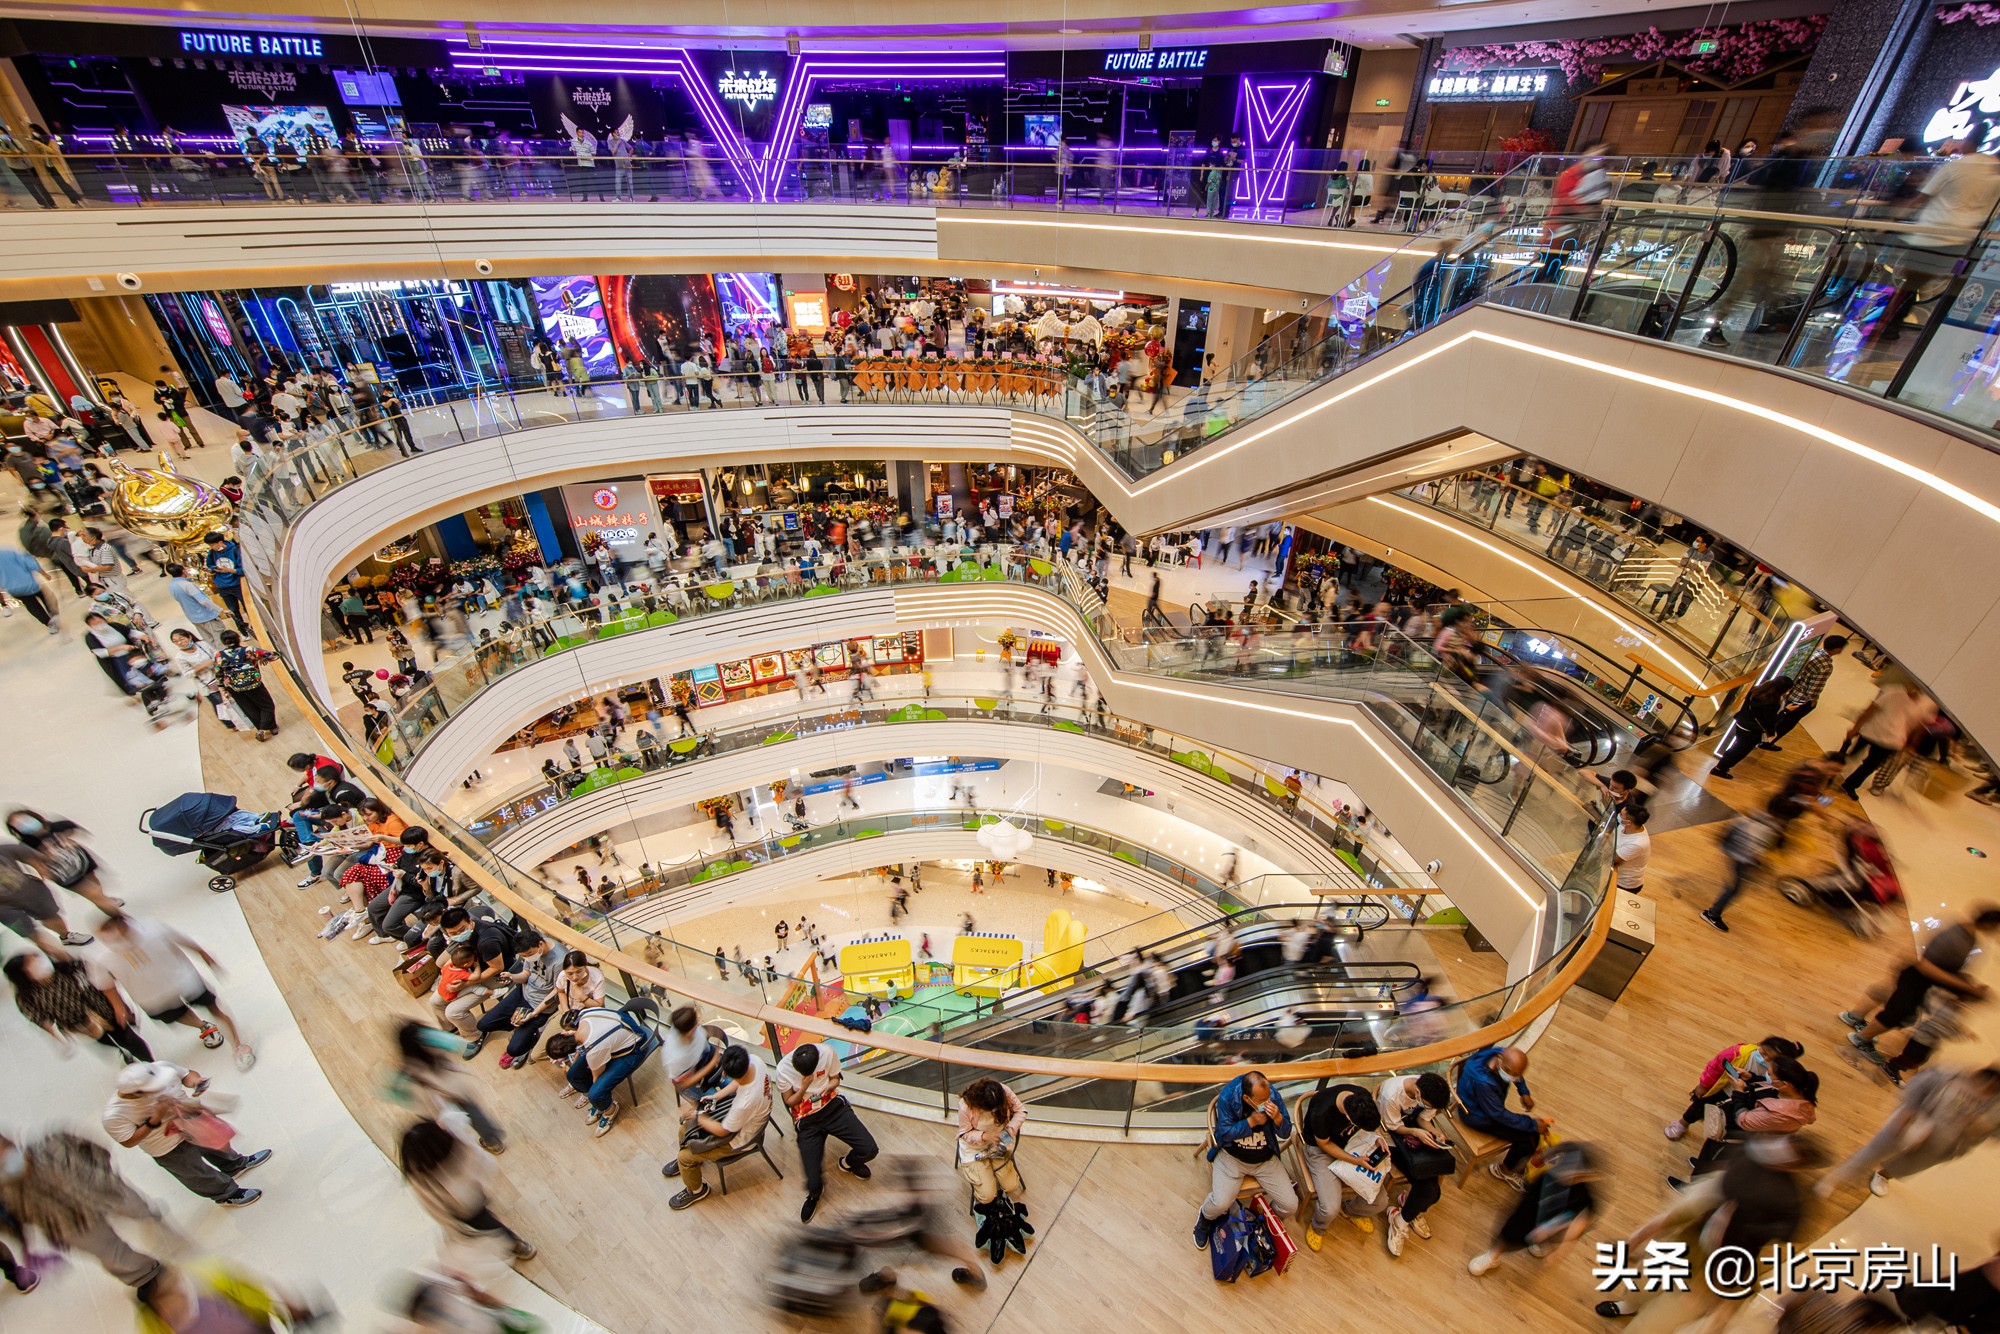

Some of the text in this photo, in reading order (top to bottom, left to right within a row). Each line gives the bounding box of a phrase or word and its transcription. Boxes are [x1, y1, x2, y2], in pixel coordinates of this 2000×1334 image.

[181, 32, 323, 57] FUTURE BATTLE
[1105, 51, 1208, 70] FUTURE BATTLE
[228, 70, 297, 86] 未来战场
[719, 74, 776, 94] 未来战场
[573, 89, 612, 102] 未来战场
[725, 92, 774, 101] FUTURE BATTLE
[655, 483, 699, 491] 山城辣妹子
[941, 500, 949, 511] 5
[574, 512, 648, 528] 山城辣妹子
[592, 772, 613, 782] YOUNG
